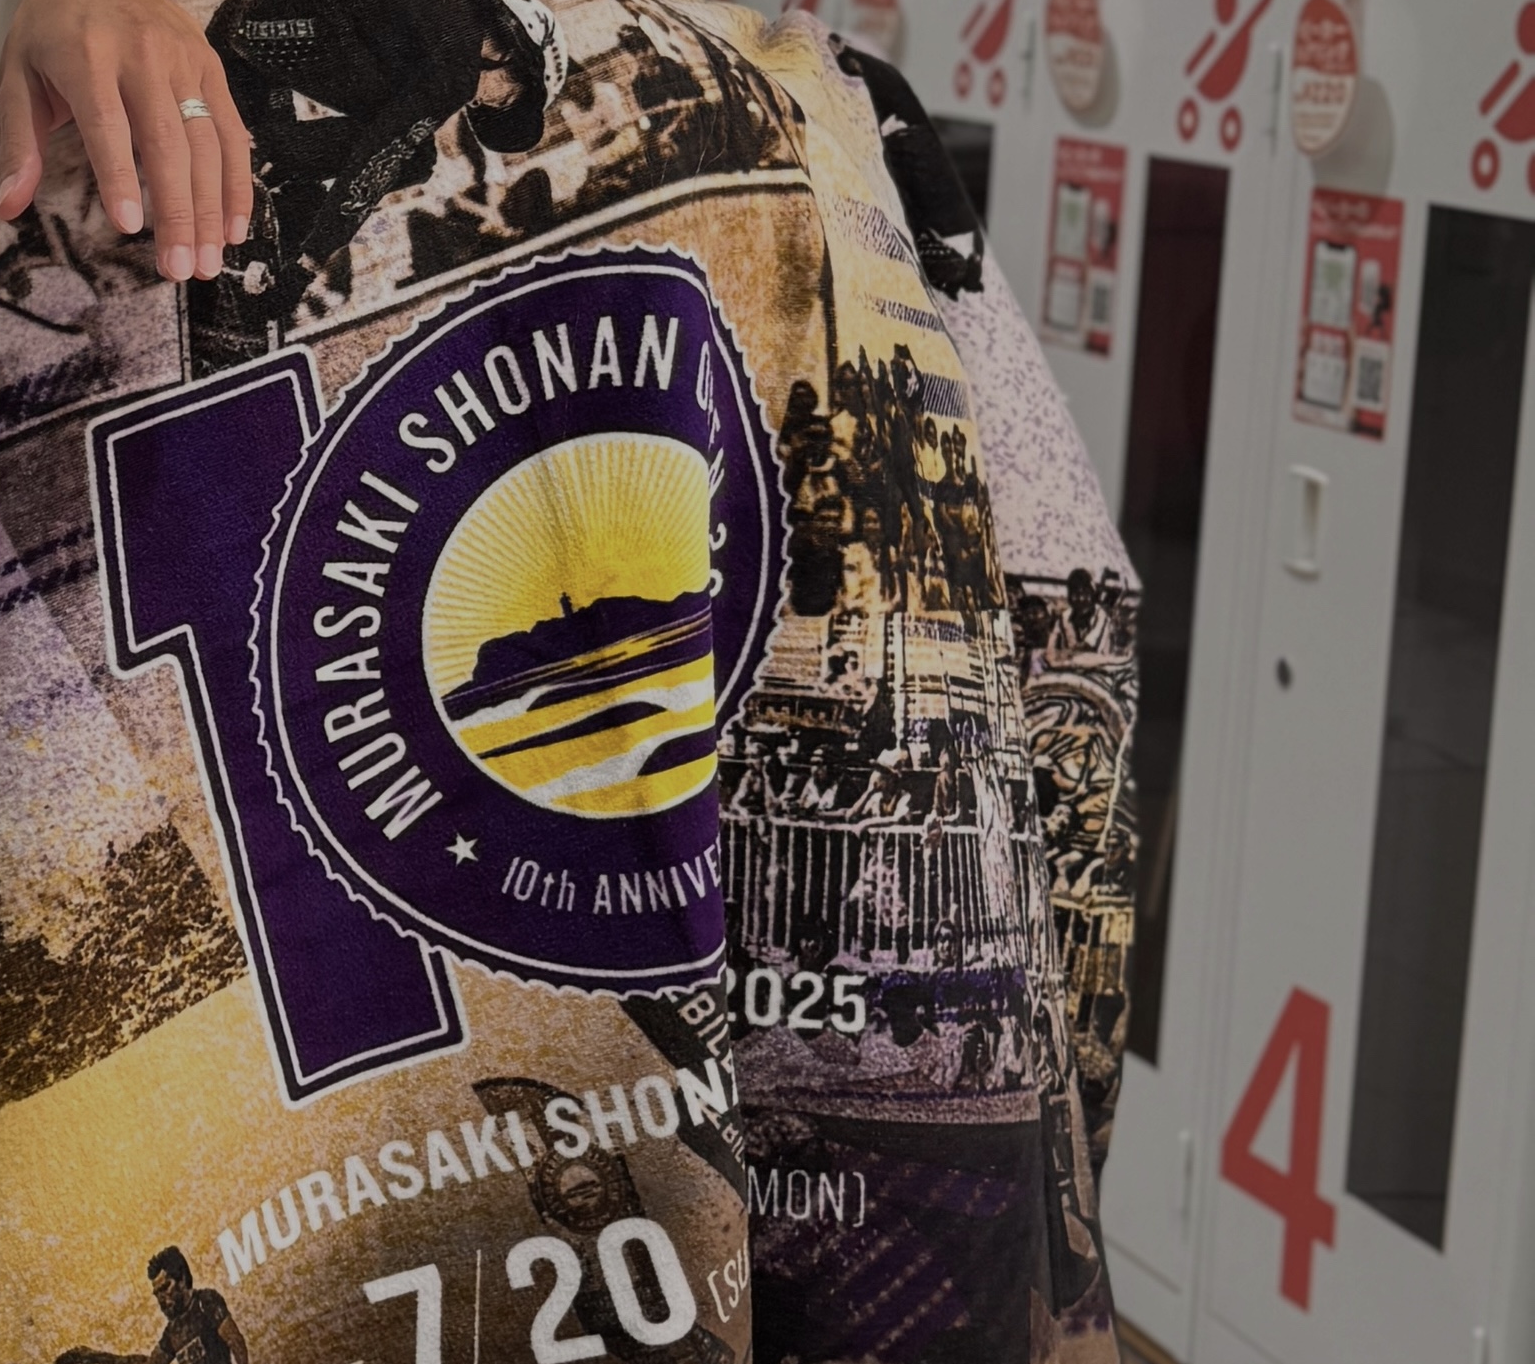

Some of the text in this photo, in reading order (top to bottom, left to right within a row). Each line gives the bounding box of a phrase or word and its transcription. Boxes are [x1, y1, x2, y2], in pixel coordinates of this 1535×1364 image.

[313, 470, 444, 842] MURASAKI
[397, 313, 679, 474] SHONAN
[500, 834, 722, 916] 10th ANNIVE
[216, 1114, 535, 1286] MURASAKI
[544, 1056, 739, 1160] SHON
[1220, 986, 1336, 1311] 4
